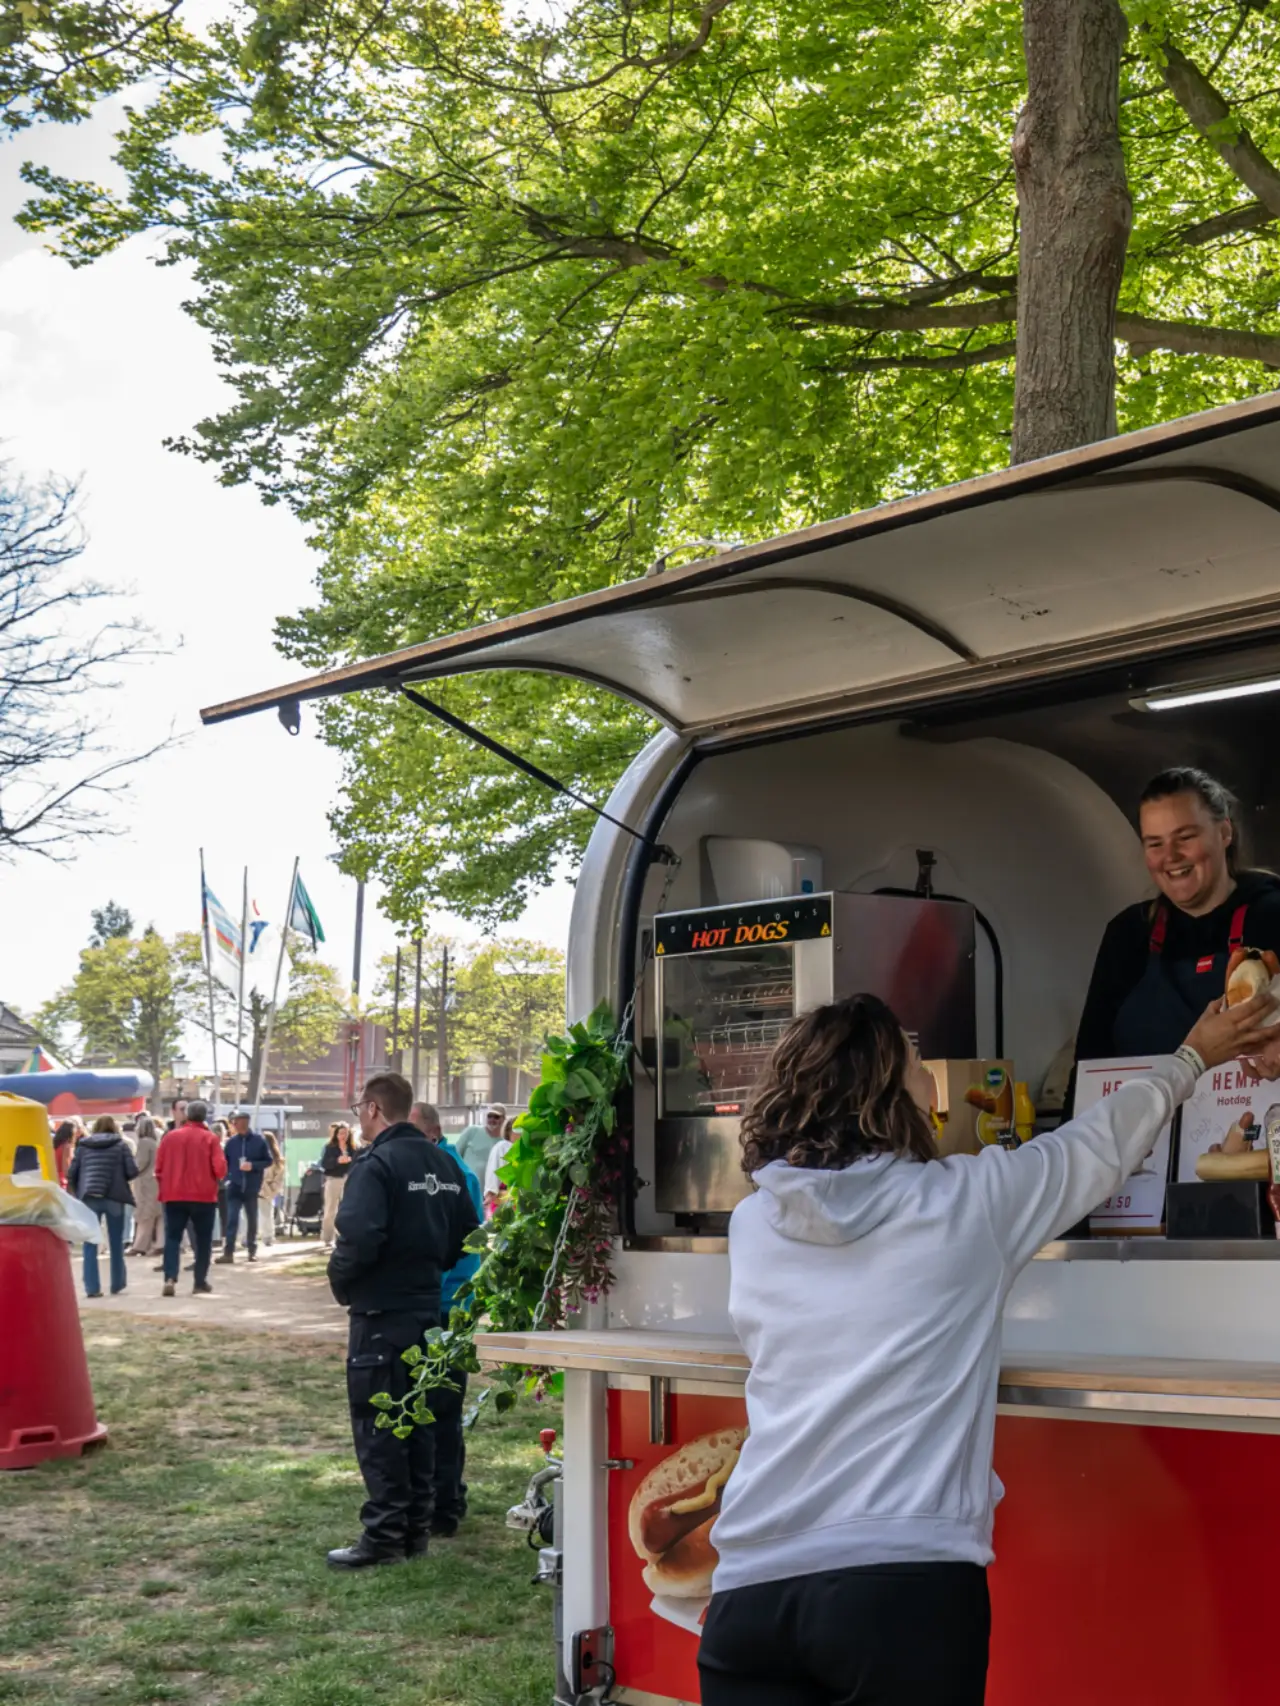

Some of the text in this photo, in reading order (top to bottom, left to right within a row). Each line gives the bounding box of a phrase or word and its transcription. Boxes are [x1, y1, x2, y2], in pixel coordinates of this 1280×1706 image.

[670, 908, 818, 934] DELICIOUS
[692, 920, 790, 949] HOT DOGS
[1217, 1095, 1252, 1107] Hotdog
